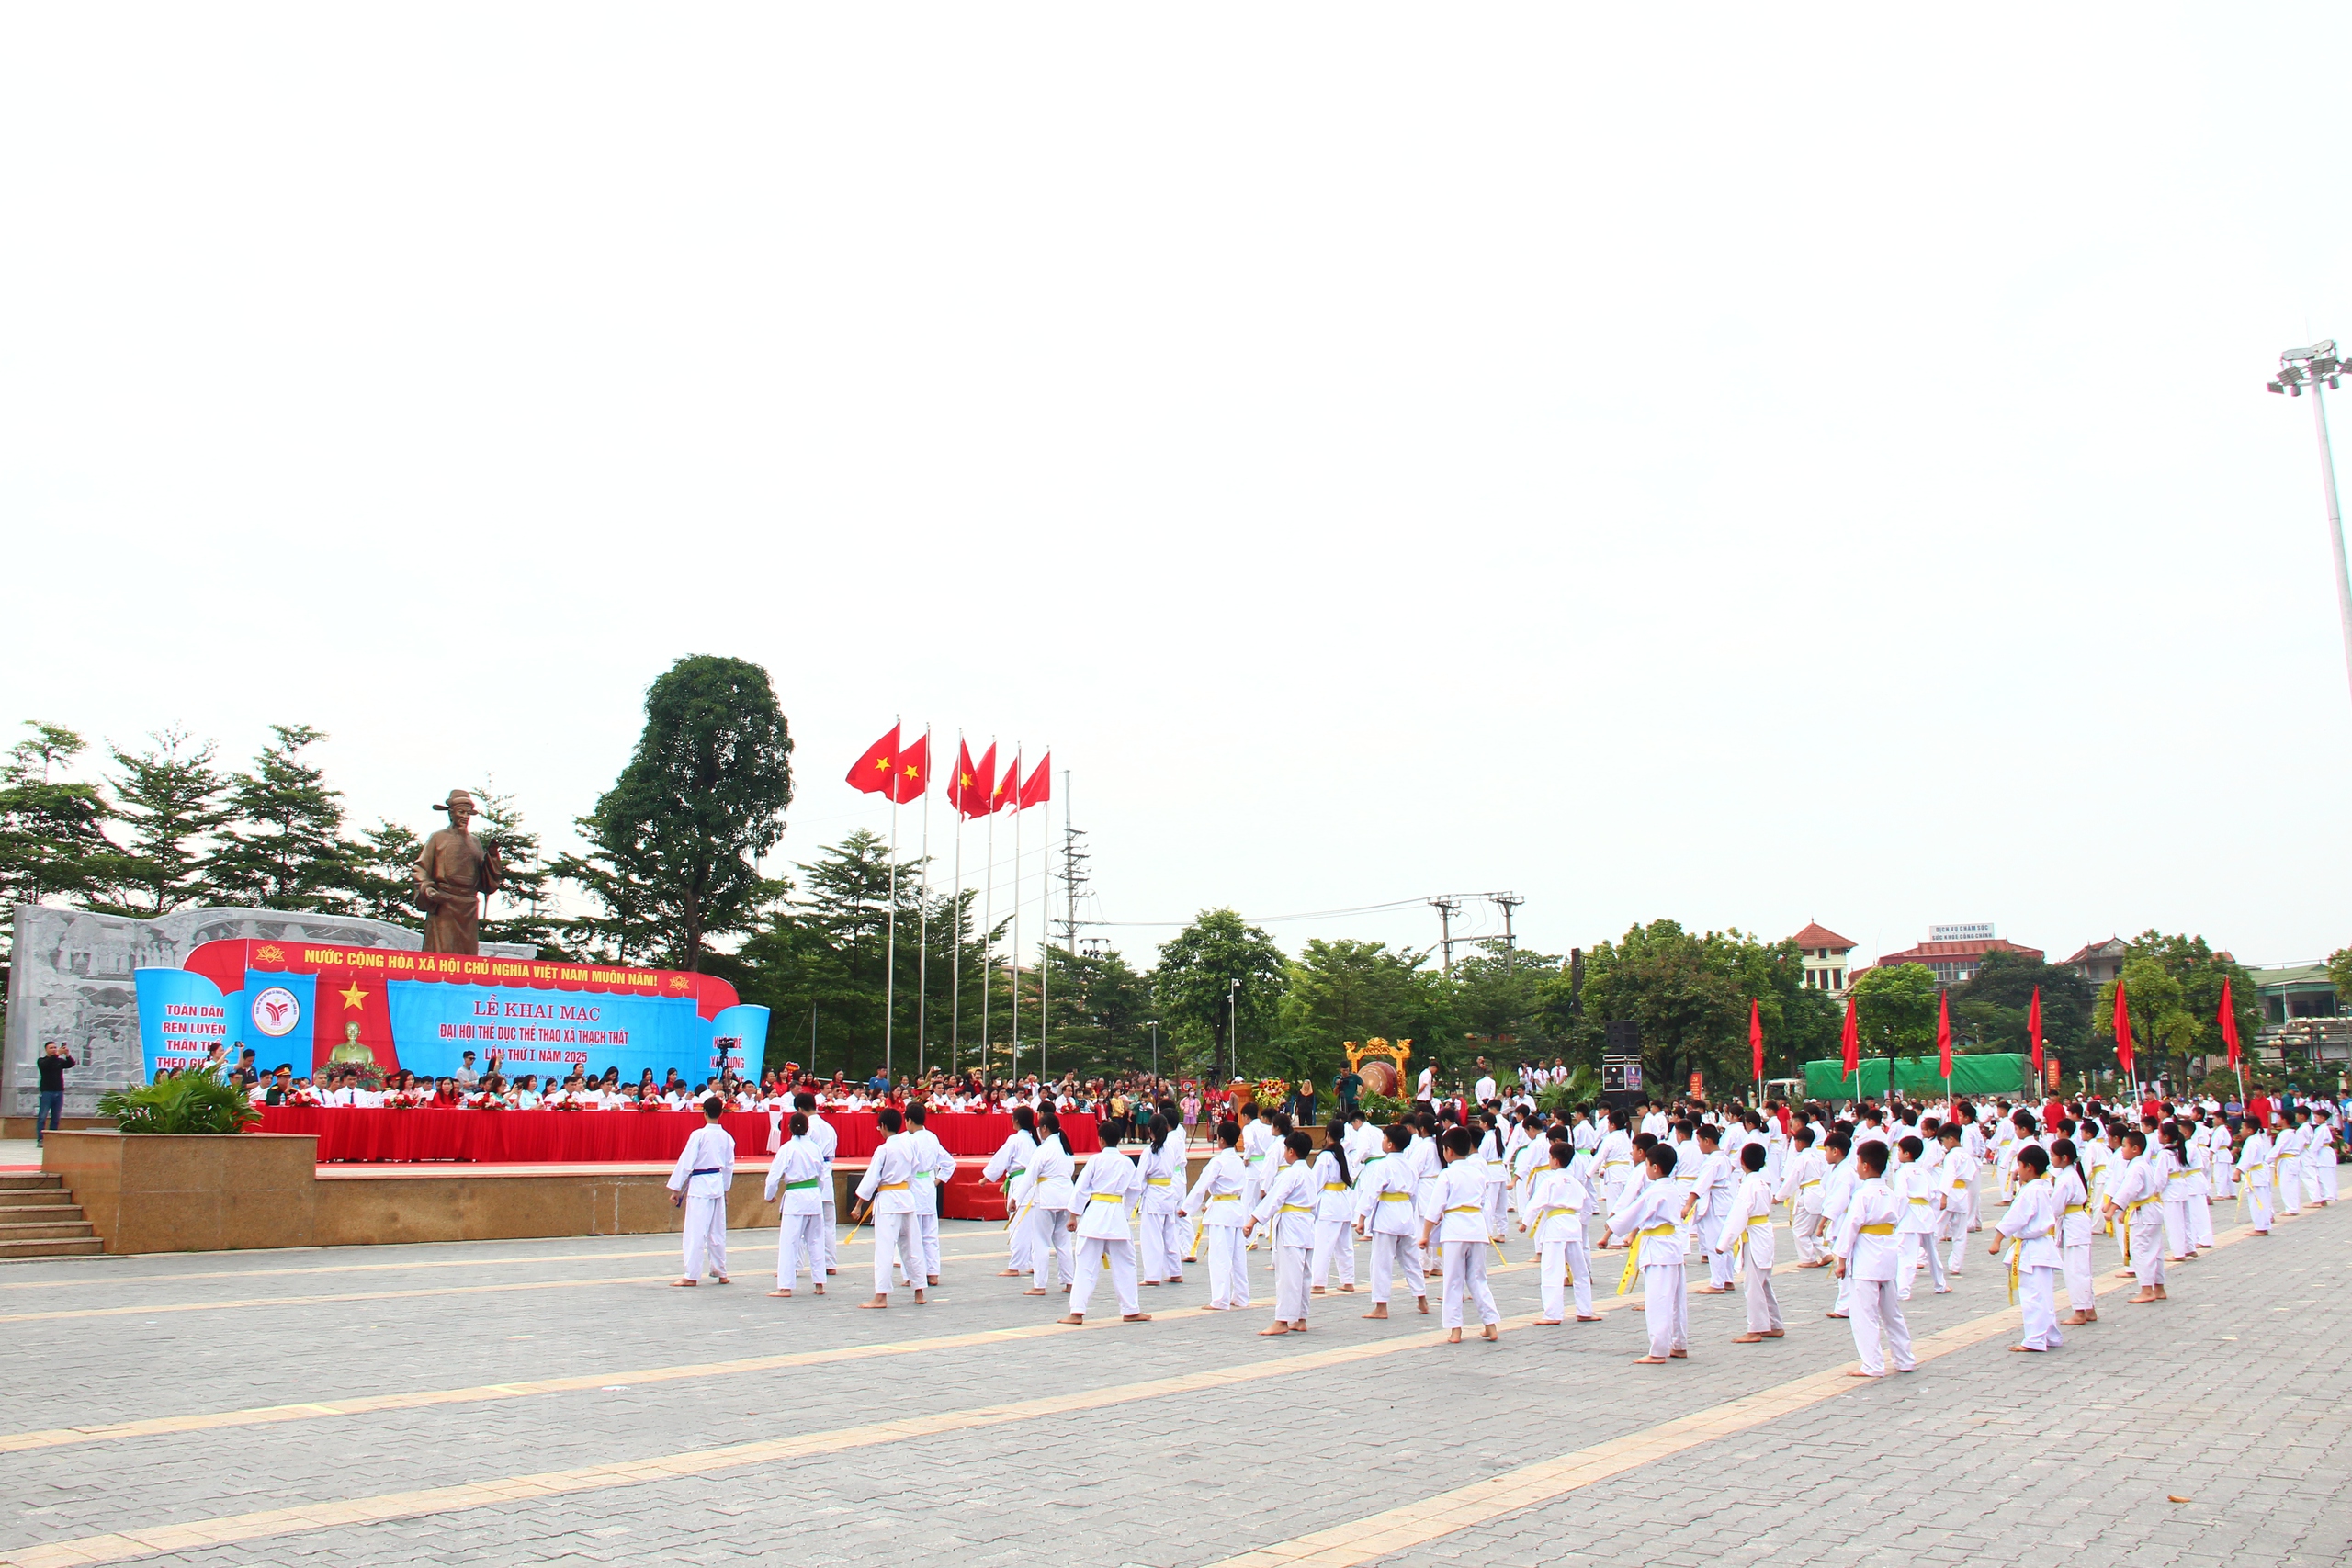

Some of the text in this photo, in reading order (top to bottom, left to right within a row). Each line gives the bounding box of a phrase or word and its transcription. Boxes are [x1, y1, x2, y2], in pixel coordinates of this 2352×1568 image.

[304, 949, 658, 986] NƯỚC CỘNG HÒA XÃ HỘI CHỦ NGHĨA VIỆT NAM MUÔN NĂM!
[167, 1003, 224, 1017] TOÀN DÂN
[474, 994, 600, 1023] LỄ KHAI MẠC
[163, 1021, 226, 1036] RÈN LUYỆN
[440, 1021, 628, 1046] ĐẠI HỘI THỂ DỤC THỂ THAO XÃ THẠCH THẤT
[166, 1038, 197, 1051] THÂN
[508, 1047, 528, 1060] THỨ
[529, 1049, 535, 1061] I
[538, 1048, 561, 1062] NĂM
[564, 1051, 587, 1063] 2025
[157, 1057, 186, 1069] THEO
